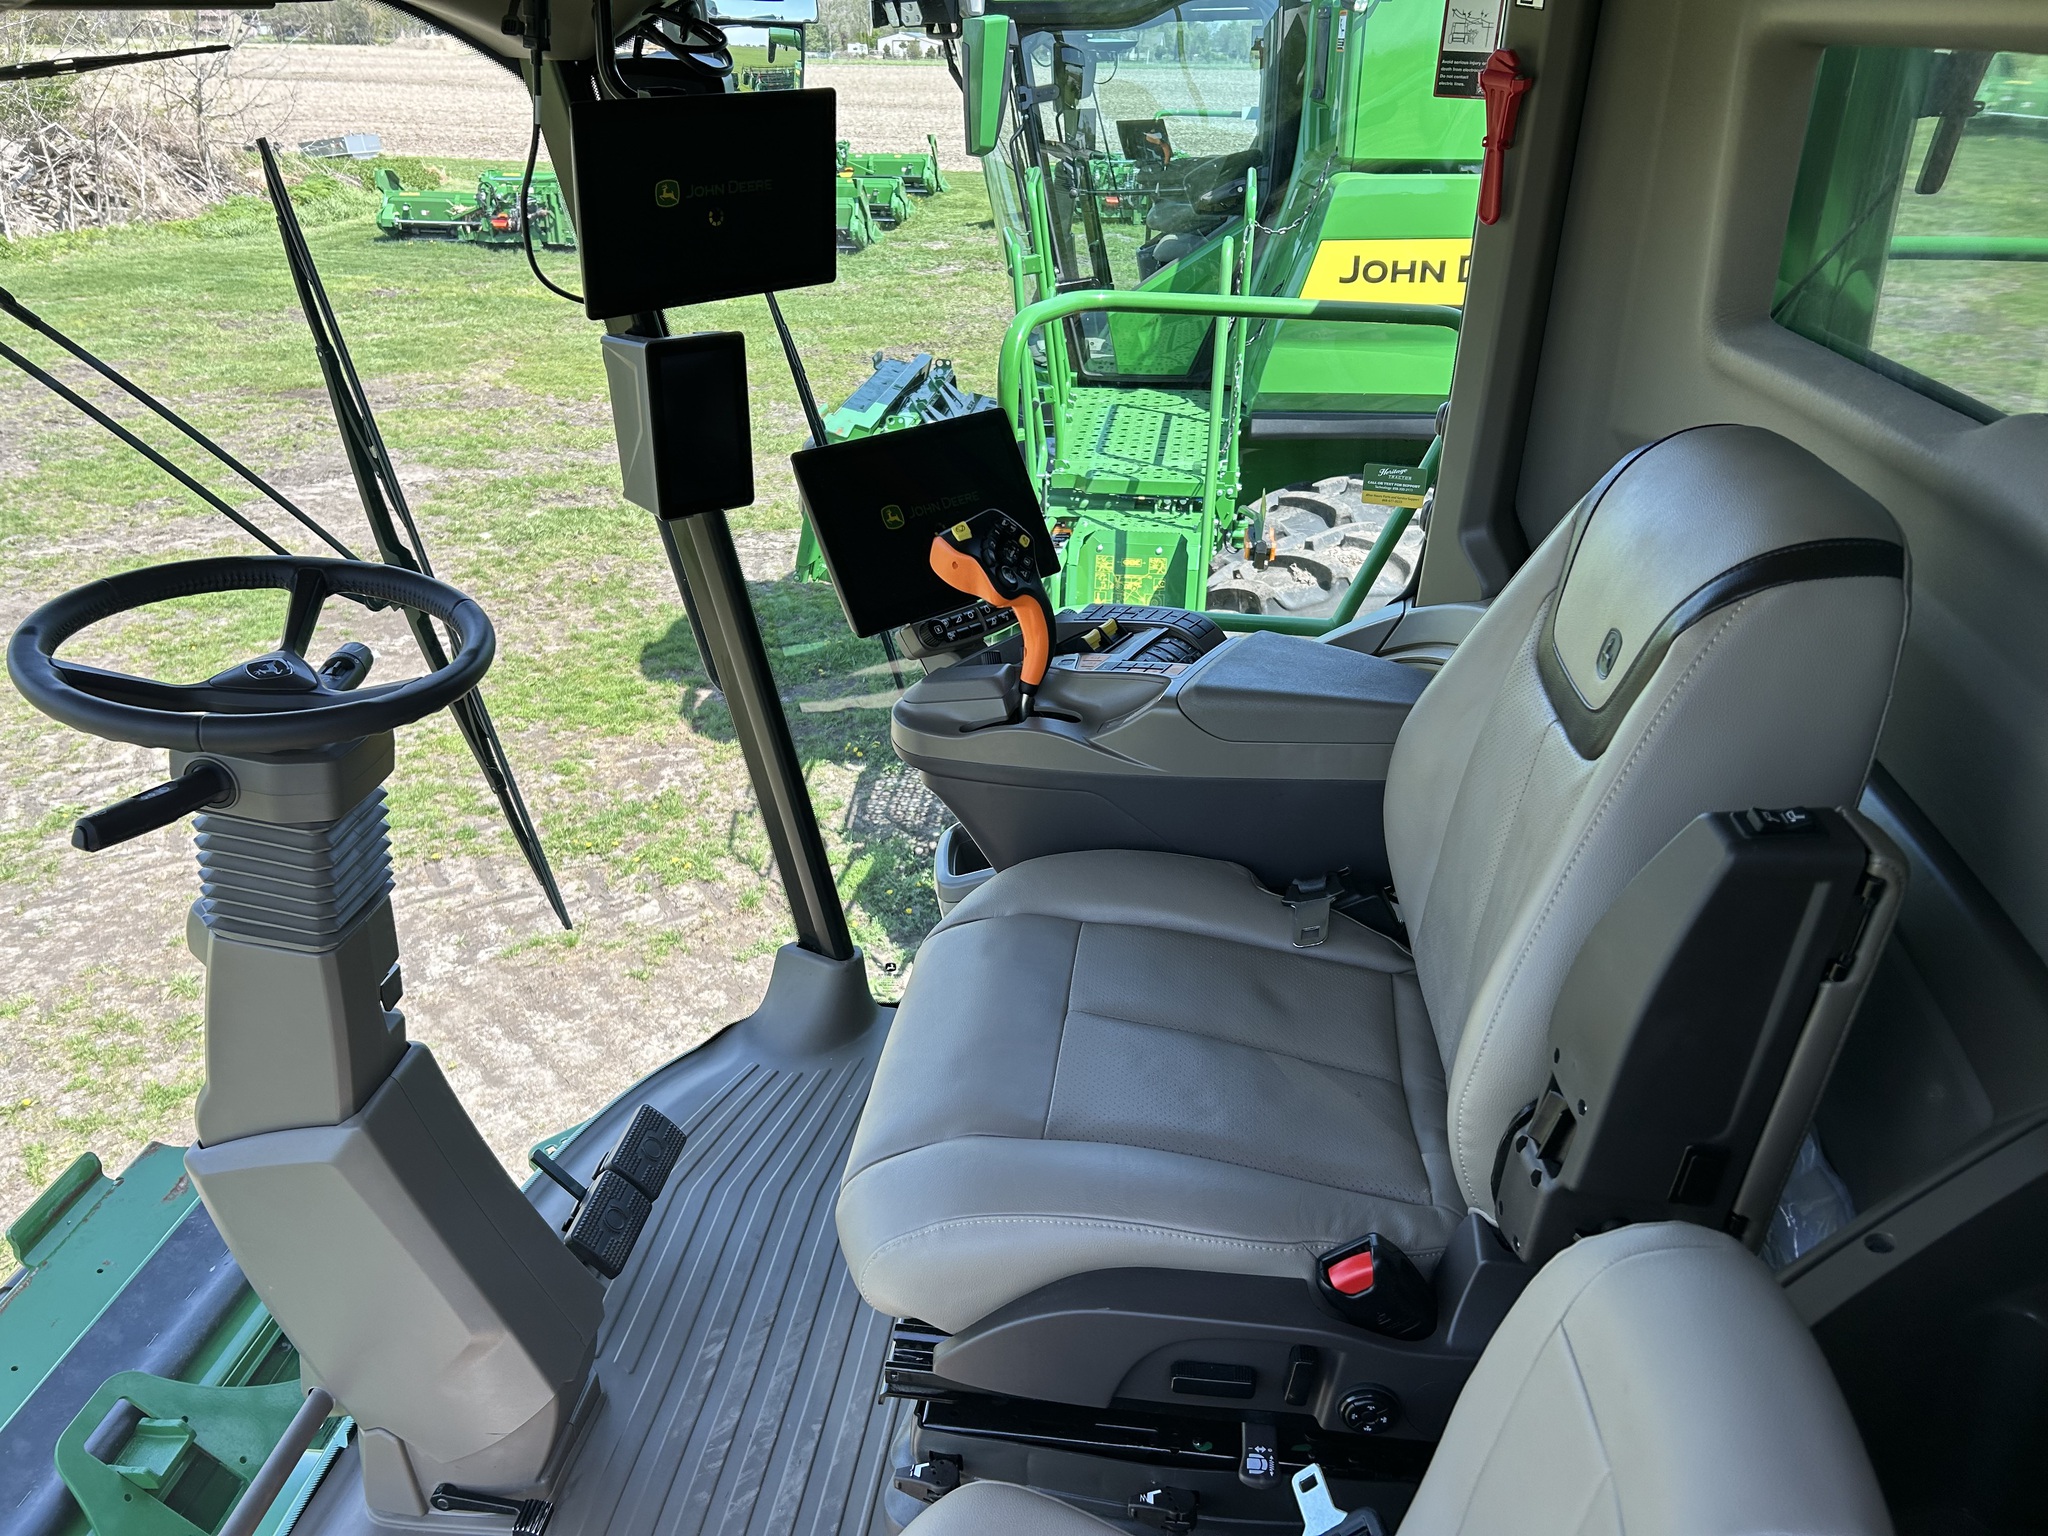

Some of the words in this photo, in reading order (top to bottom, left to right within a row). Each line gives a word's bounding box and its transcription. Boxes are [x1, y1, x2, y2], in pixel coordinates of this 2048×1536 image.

[685, 183, 725, 199] JOHN
[727, 179, 774, 194] DEERE
[1339, 255, 1446, 283] JOHN
[1378, 468, 1408, 476] Heritage
[908, 501, 941, 519] JOHN
[941, 490, 980, 509] DEERE
